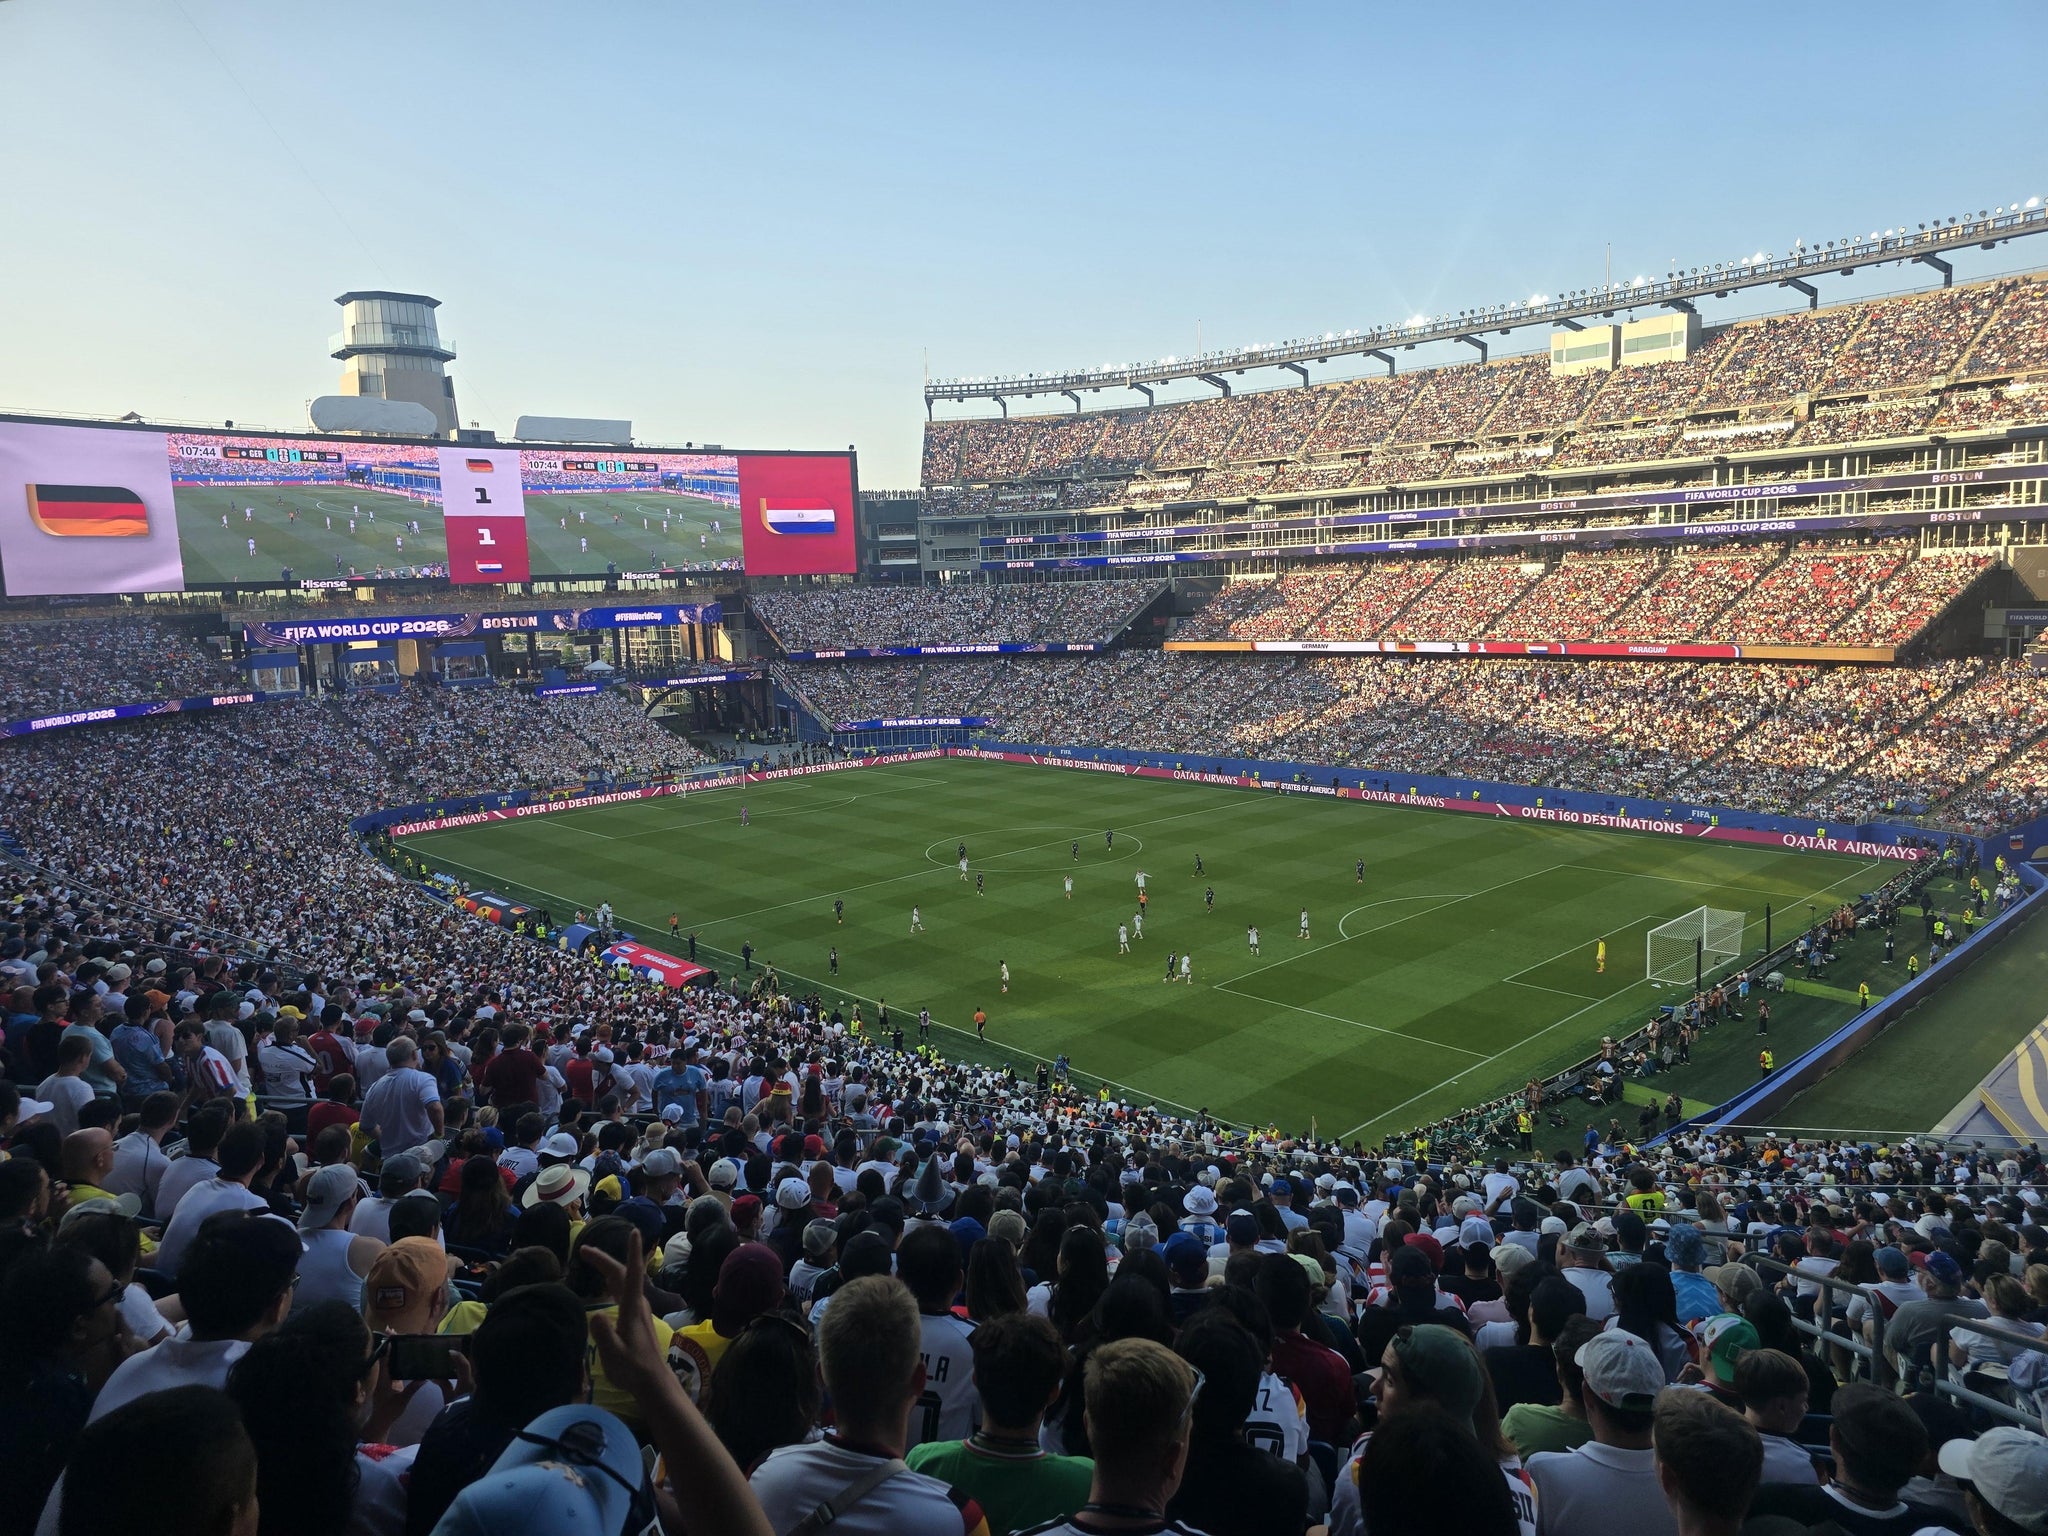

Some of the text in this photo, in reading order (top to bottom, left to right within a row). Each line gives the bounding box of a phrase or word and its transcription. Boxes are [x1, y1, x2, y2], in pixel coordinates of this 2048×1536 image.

[179, 446, 216, 457] 107:44
[249, 450, 263, 458] GER
[303, 452, 318, 461] PAR
[529, 461, 557, 469] 107:44
[1932, 471, 1983, 483] BOSTON
[475, 488, 491, 503] 1
[1686, 485, 1797, 501] FIFA WORLD CUP 2026
[1540, 501, 1577, 511] BOSTON
[1930, 511, 1981, 522] BOSTON
[1684, 521, 1796, 535] FIFA WORLD CUP 2026
[478, 529, 496, 545] 1
[1540, 533, 1576, 542] BOSTON
[1252, 549, 1279, 557] BOSTON
[622, 572, 660, 580] Hisense
[300, 579, 348, 589] Hisense
[483, 616, 537, 629] BOSTON
[615, 612, 662, 622] #FIFAWorldCup
[285, 619, 449, 640] FIFA WORLD CUP 2026
[213, 694, 253, 706] BOSTON
[31, 709, 116, 730] FIFA WORLD CUP 2026
[883, 750, 940, 764] QATAR AIRWAYS
[957, 749, 1004, 760] QATAR AIRWAYS
[766, 759, 863, 780] OVER 160 DESTINATIONS
[1043, 757, 1126, 773] OVER 160 DESTINATIONS
[1173, 770, 1238, 785] QATAR AIRWAYS
[670, 782, 700, 793] QATAR
[1262, 780, 1277, 788] UNIT
[1281, 782, 1300, 791] STATES
[1310, 785, 1335, 795] AMERICA
[517, 790, 642, 817] OVER 160 DESTINATIONS
[1362, 790, 1445, 808] QATAR AIRWAYS
[1521, 807, 1683, 834] OVER 160 DESTINATIONS
[1691, 809, 1710, 819] FIFA
[397, 812, 488, 835] QATAR AIRWAYS
[1783, 833, 1918, 861] QATAR AIRWAYS
